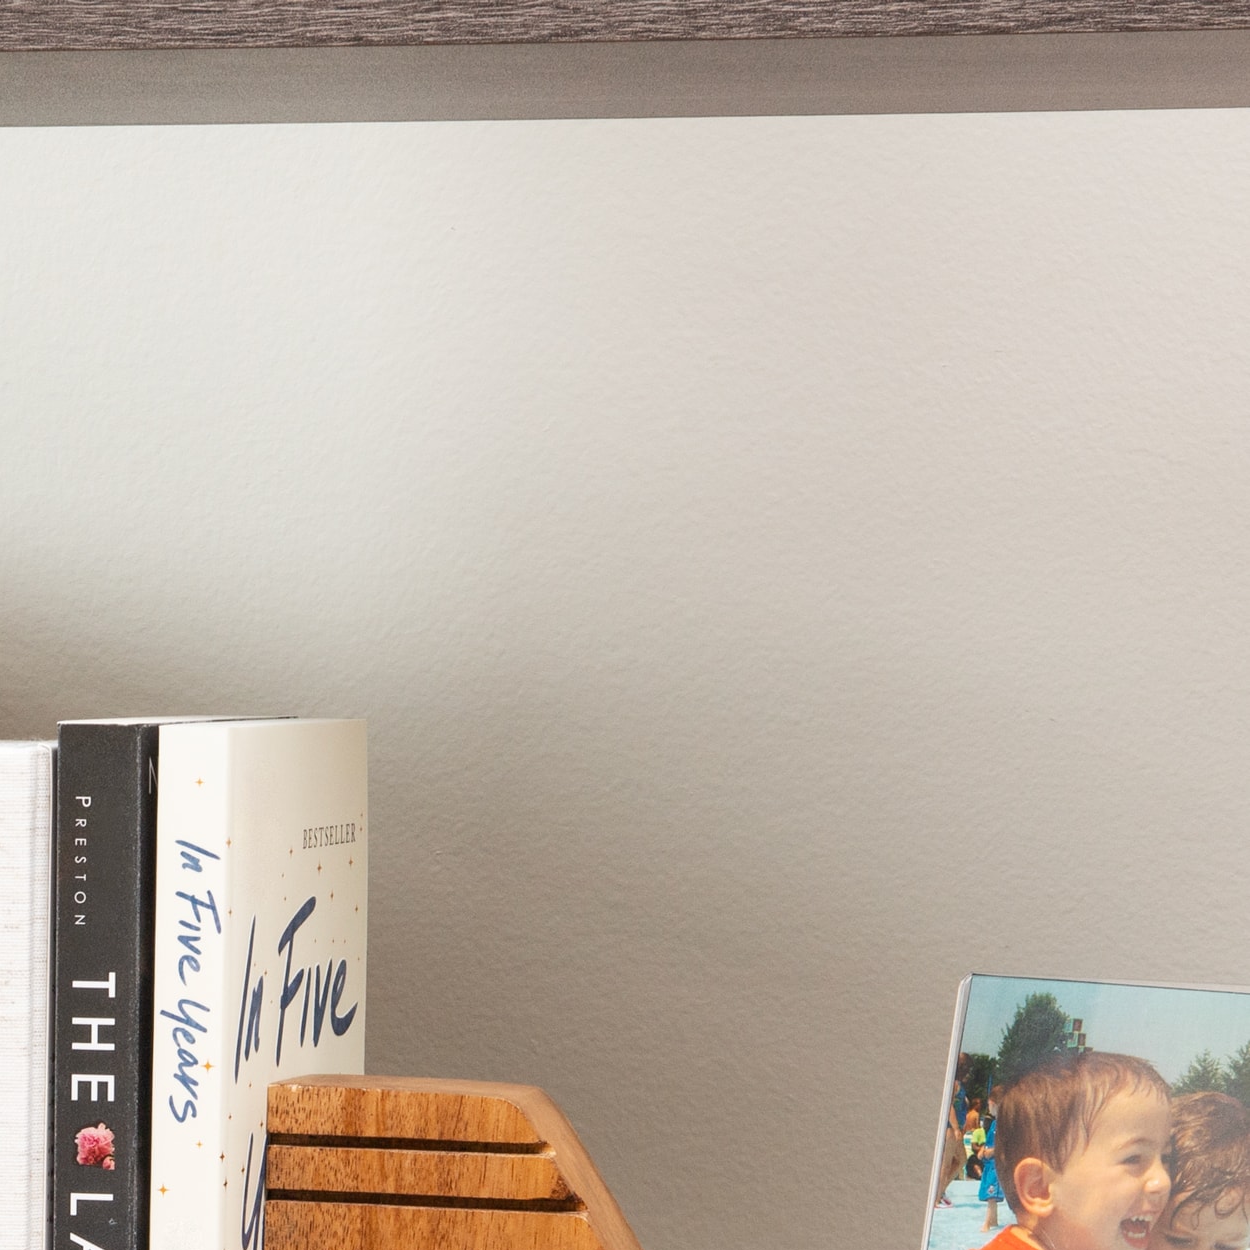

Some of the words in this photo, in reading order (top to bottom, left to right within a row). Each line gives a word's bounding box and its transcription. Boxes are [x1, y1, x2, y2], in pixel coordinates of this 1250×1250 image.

[74, 796, 92, 925] PRESTON
[175, 839, 221, 873] In
[302, 822, 357, 850] BESTSELLER
[175, 890, 221, 986] Five
[234, 914, 264, 1084] In
[275, 896, 358, 1068] Five
[71, 972, 116, 1102] THE
[160, 998, 210, 1124] Years
